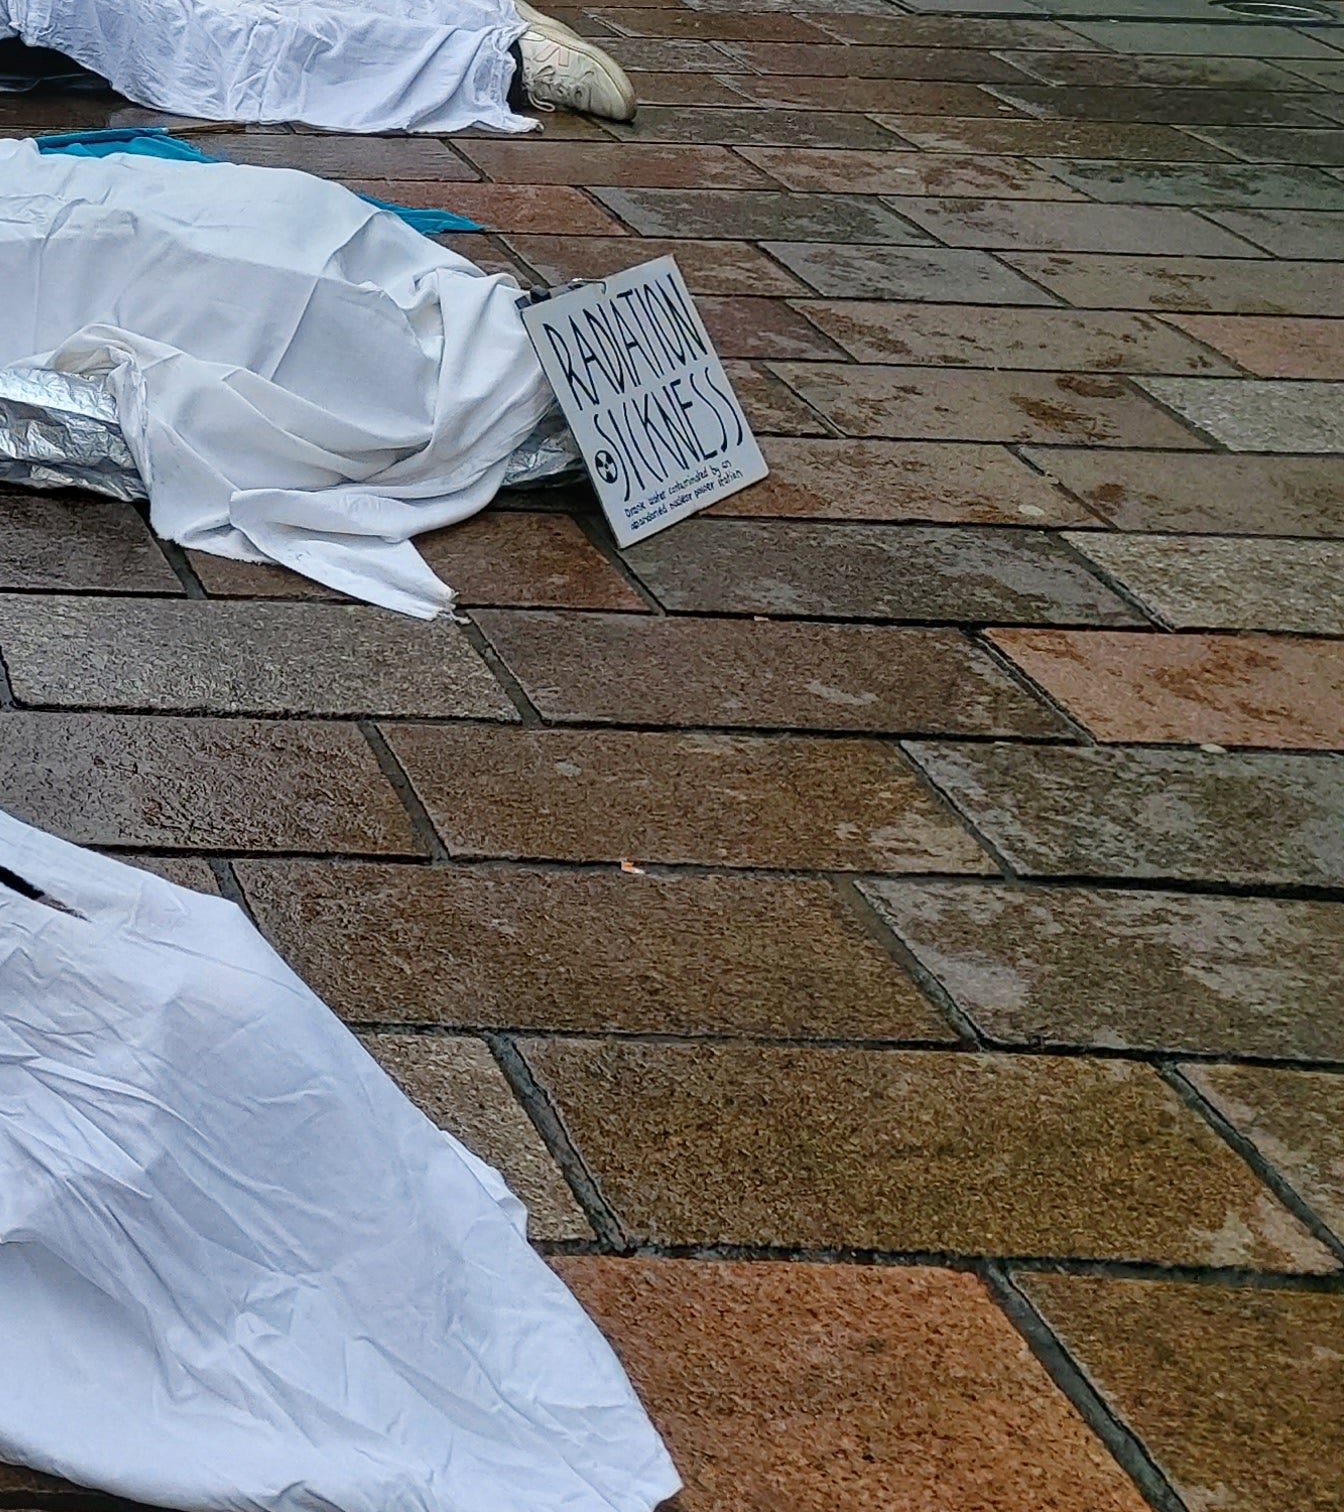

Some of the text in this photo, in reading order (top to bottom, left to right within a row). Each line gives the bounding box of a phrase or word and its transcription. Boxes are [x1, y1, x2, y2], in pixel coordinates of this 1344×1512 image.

[543, 273, 708, 411] RADIATION
[593, 367, 744, 502] SICKNESS
[648, 491, 667, 506] water
[710, 461, 722, 480] by
[722, 459, 732, 470] an
[694, 482, 716, 501] power
[716, 468, 744, 487] station
